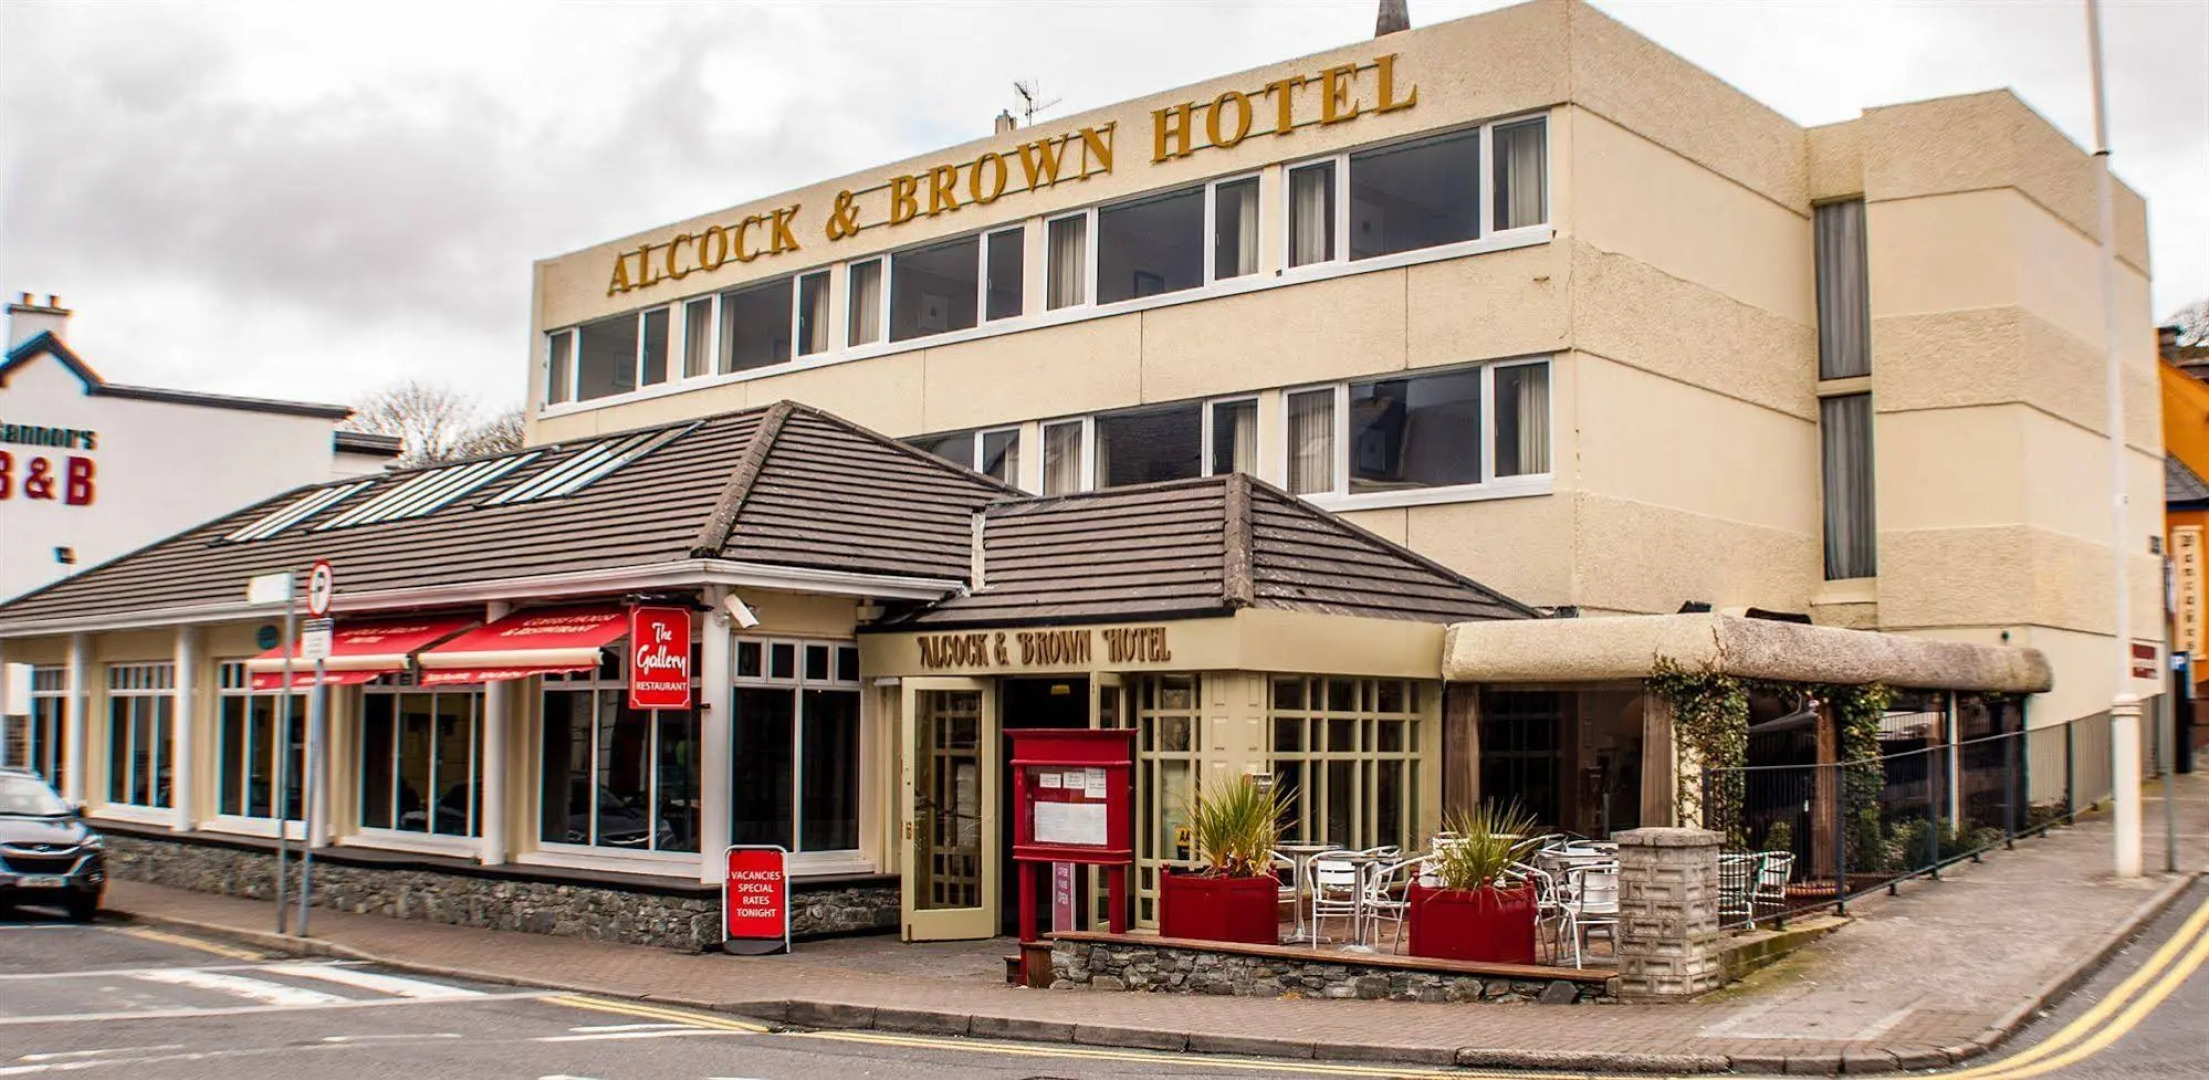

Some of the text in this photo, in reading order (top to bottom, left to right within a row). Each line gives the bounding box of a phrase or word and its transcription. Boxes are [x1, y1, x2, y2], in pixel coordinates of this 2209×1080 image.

[606, 52, 1419, 295] ALCOCK & BROWN HOTEL
[25, 456, 56, 500] &
[65, 455, 97, 506] B
[651, 622, 673, 643] The
[917, 627, 1172, 668] ALCOCK & BROWN HOTEL
[636, 644, 687, 678] Gallery
[635, 681, 687, 691] RESTAURANT
[731, 871, 781, 881] VACANCIES
[738, 883, 774, 893] SPECIAL
[742, 896, 770, 905] RATES
[736, 908, 777, 918] TONIGHT
